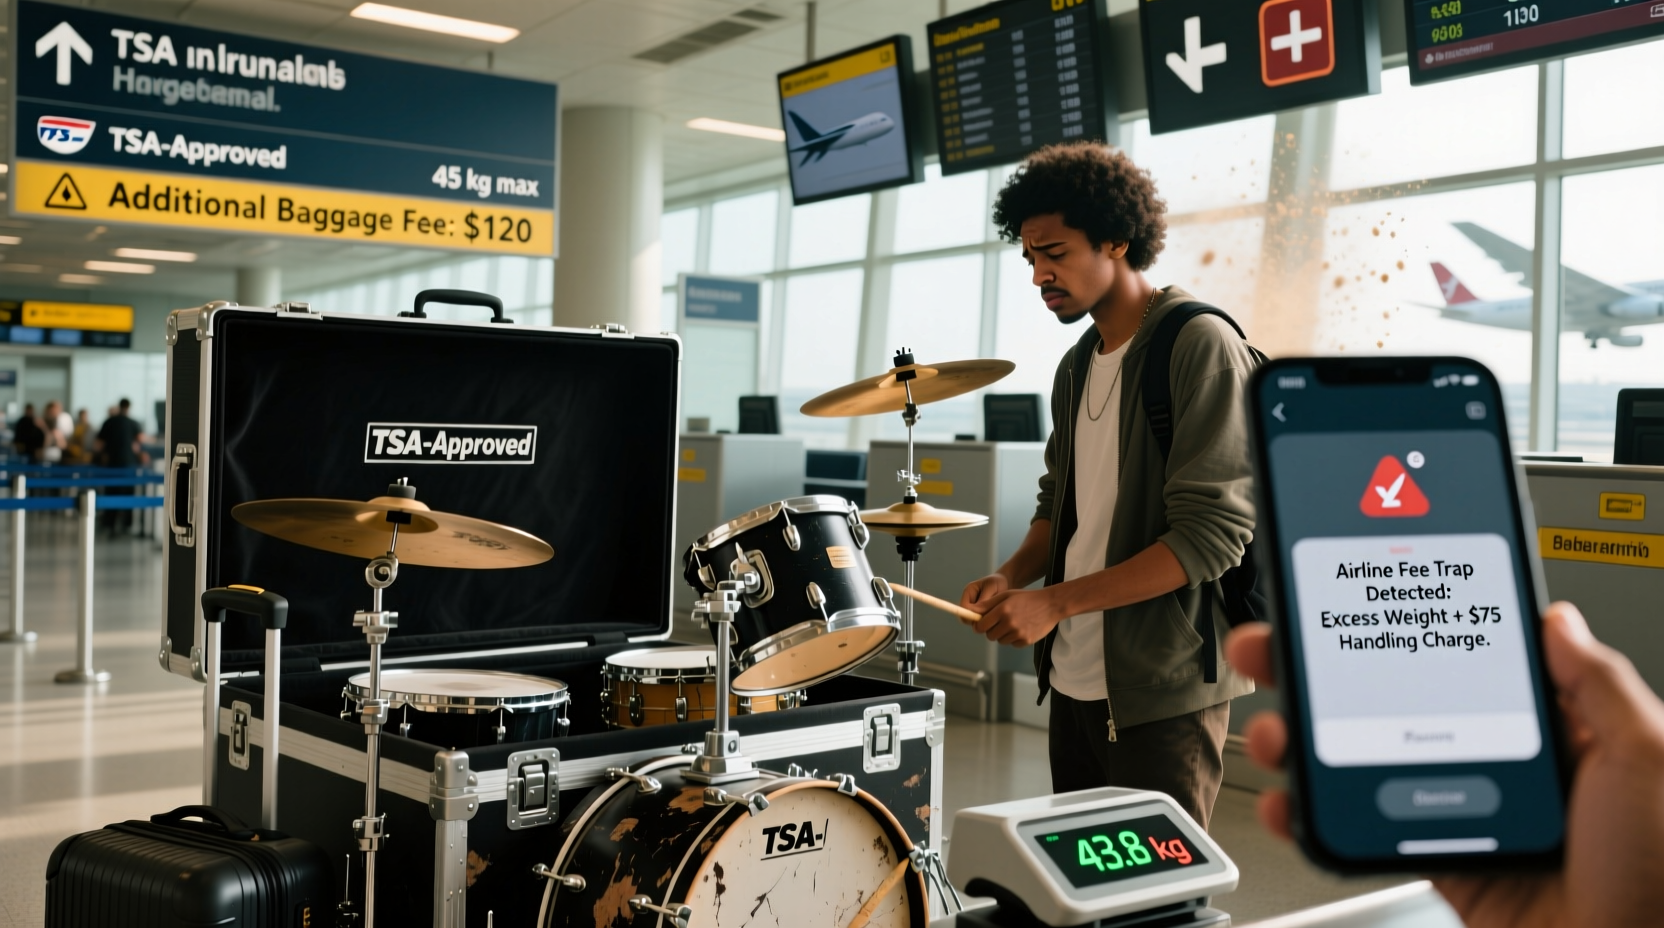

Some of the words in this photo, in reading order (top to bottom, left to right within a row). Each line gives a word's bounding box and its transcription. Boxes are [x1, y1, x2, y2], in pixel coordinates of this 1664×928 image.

[111, 28, 178, 67] TSA
[107, 126, 287, 169] TSA-Approved
[432, 165, 462, 189] 45
[466, 168, 492, 198] kg
[496, 176, 540, 197] max
[107, 182, 265, 220] Additional
[277, 197, 394, 236] Baggage
[403, 209, 455, 236] Fee:
[463, 209, 533, 244] $120
[372, 428, 533, 461] TSA-Approved
[1336, 562, 1394, 579] Airline
[1399, 561, 1430, 577] Fee
[1433, 560, 1474, 580] Trap
[1366, 583, 1451, 601] Detected:
[1321, 611, 1379, 628] Excess
[1384, 608, 1449, 629] Weight
[1468, 605, 1502, 625] $75
[1339, 632, 1418, 652] Handling
[1422, 631, 1491, 651] Charge.
[1077, 831, 1152, 871] 43.8
[1148, 836, 1193, 865] kg
